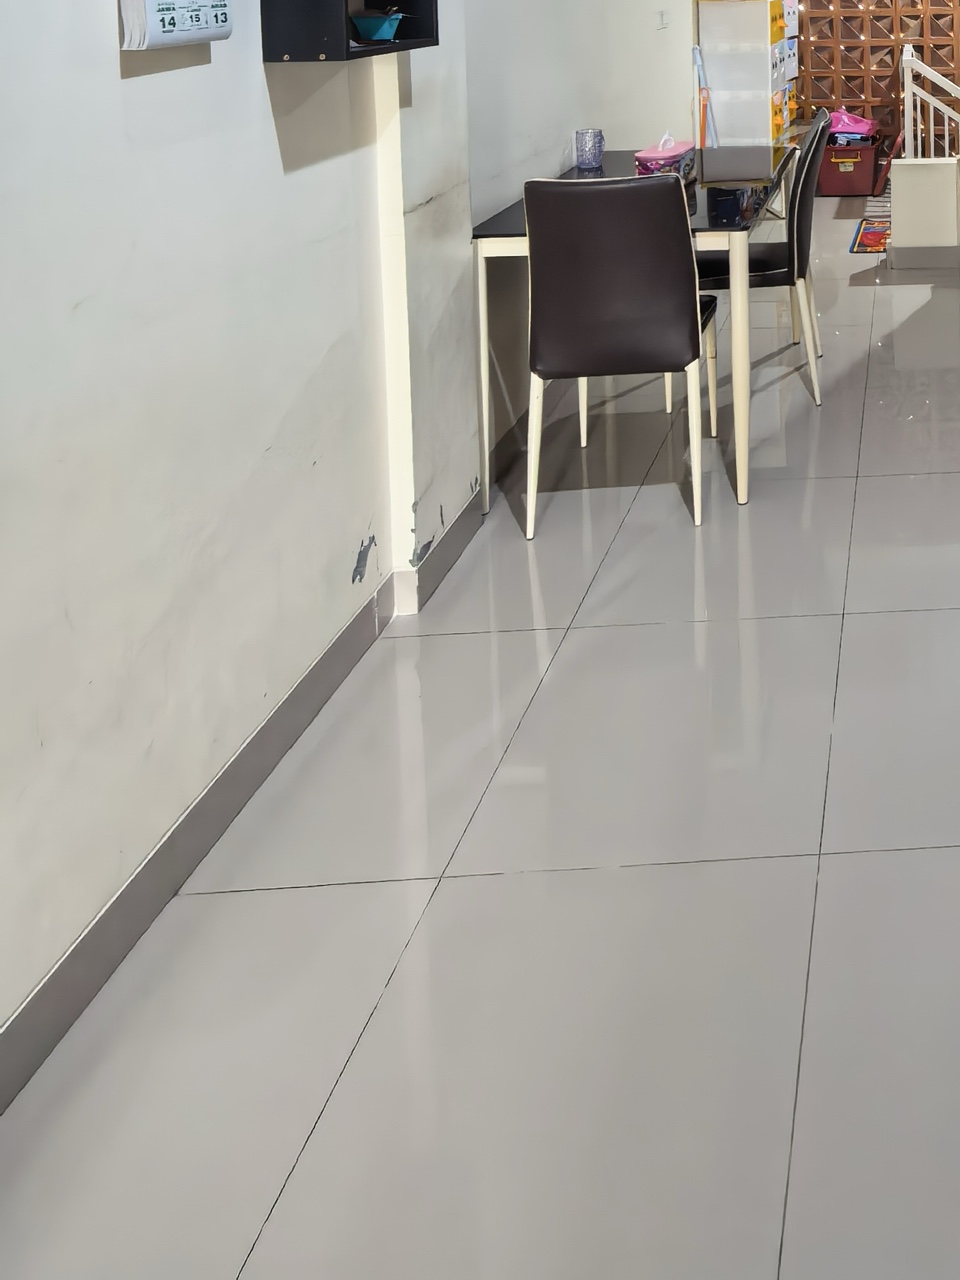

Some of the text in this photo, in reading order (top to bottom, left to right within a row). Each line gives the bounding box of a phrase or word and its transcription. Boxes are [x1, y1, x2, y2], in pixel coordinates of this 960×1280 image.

[159, 16, 176, 29] 14
[189, 14, 201, 23] 15
[213, 11, 228, 24] 13
